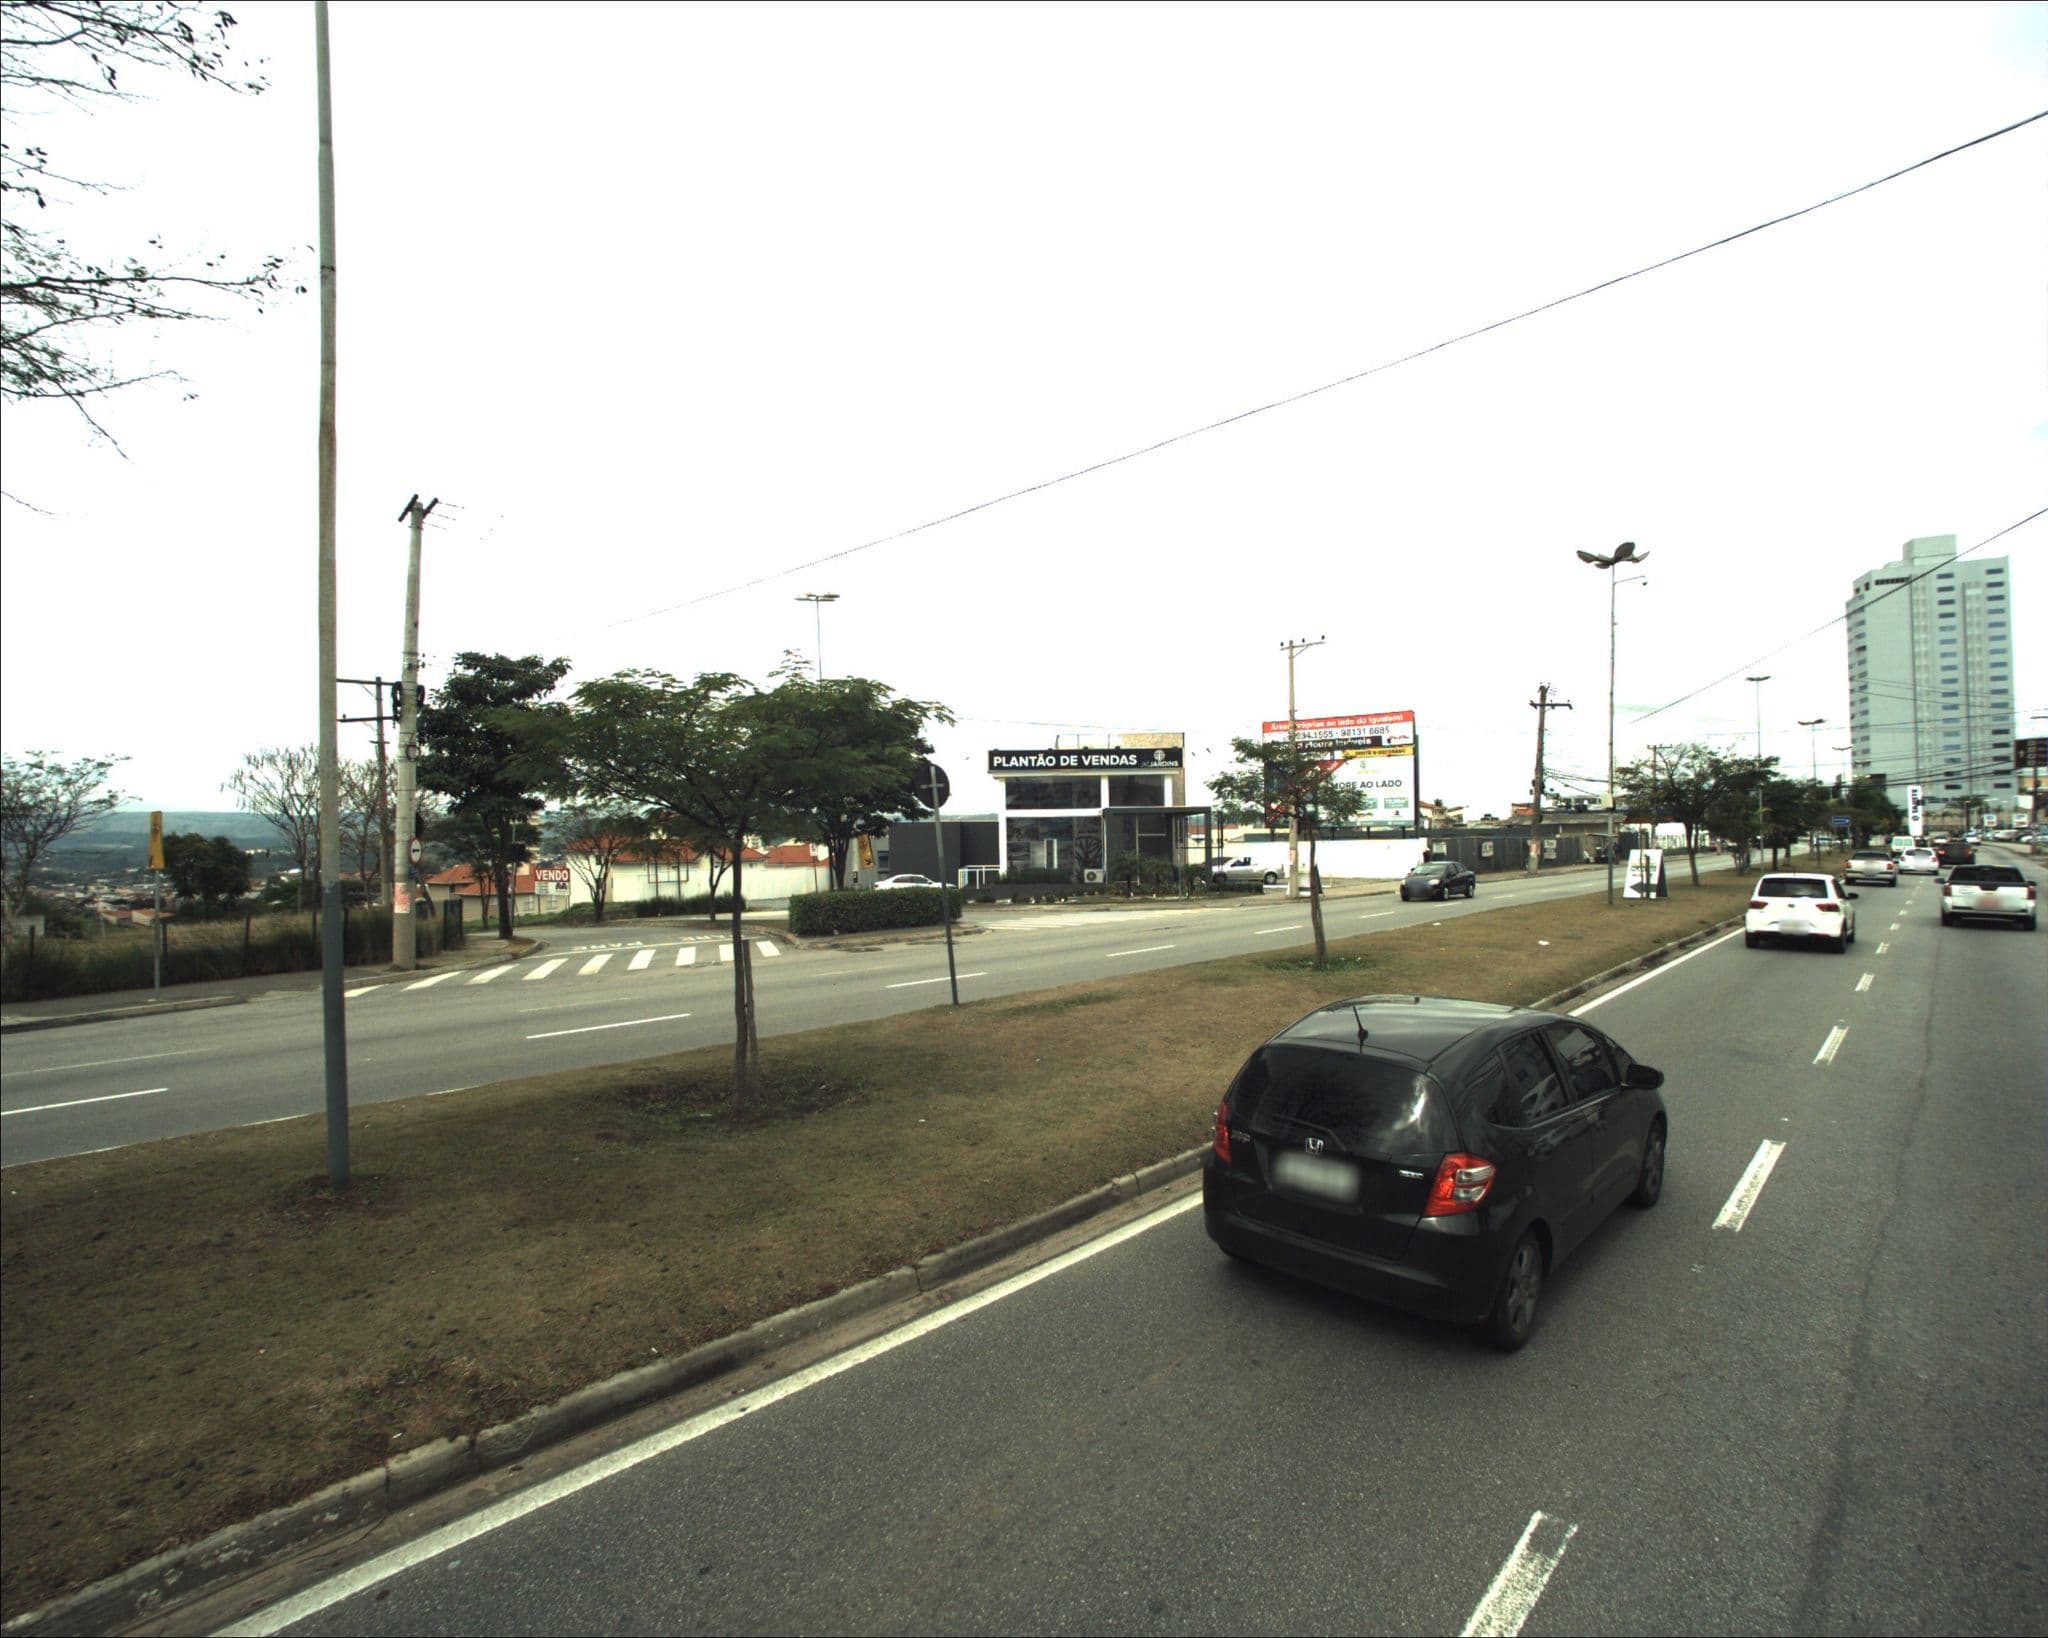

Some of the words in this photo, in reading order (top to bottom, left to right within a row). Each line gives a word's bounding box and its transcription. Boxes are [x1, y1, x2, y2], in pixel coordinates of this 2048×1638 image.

[993, 753, 1056, 767] PLANTÃO
[1060, 755, 1078, 766] DE
[1081, 754, 1138, 766] VENDAS
[1375, 779, 1402, 787] LADO
[535, 869, 568, 881] VENDO
